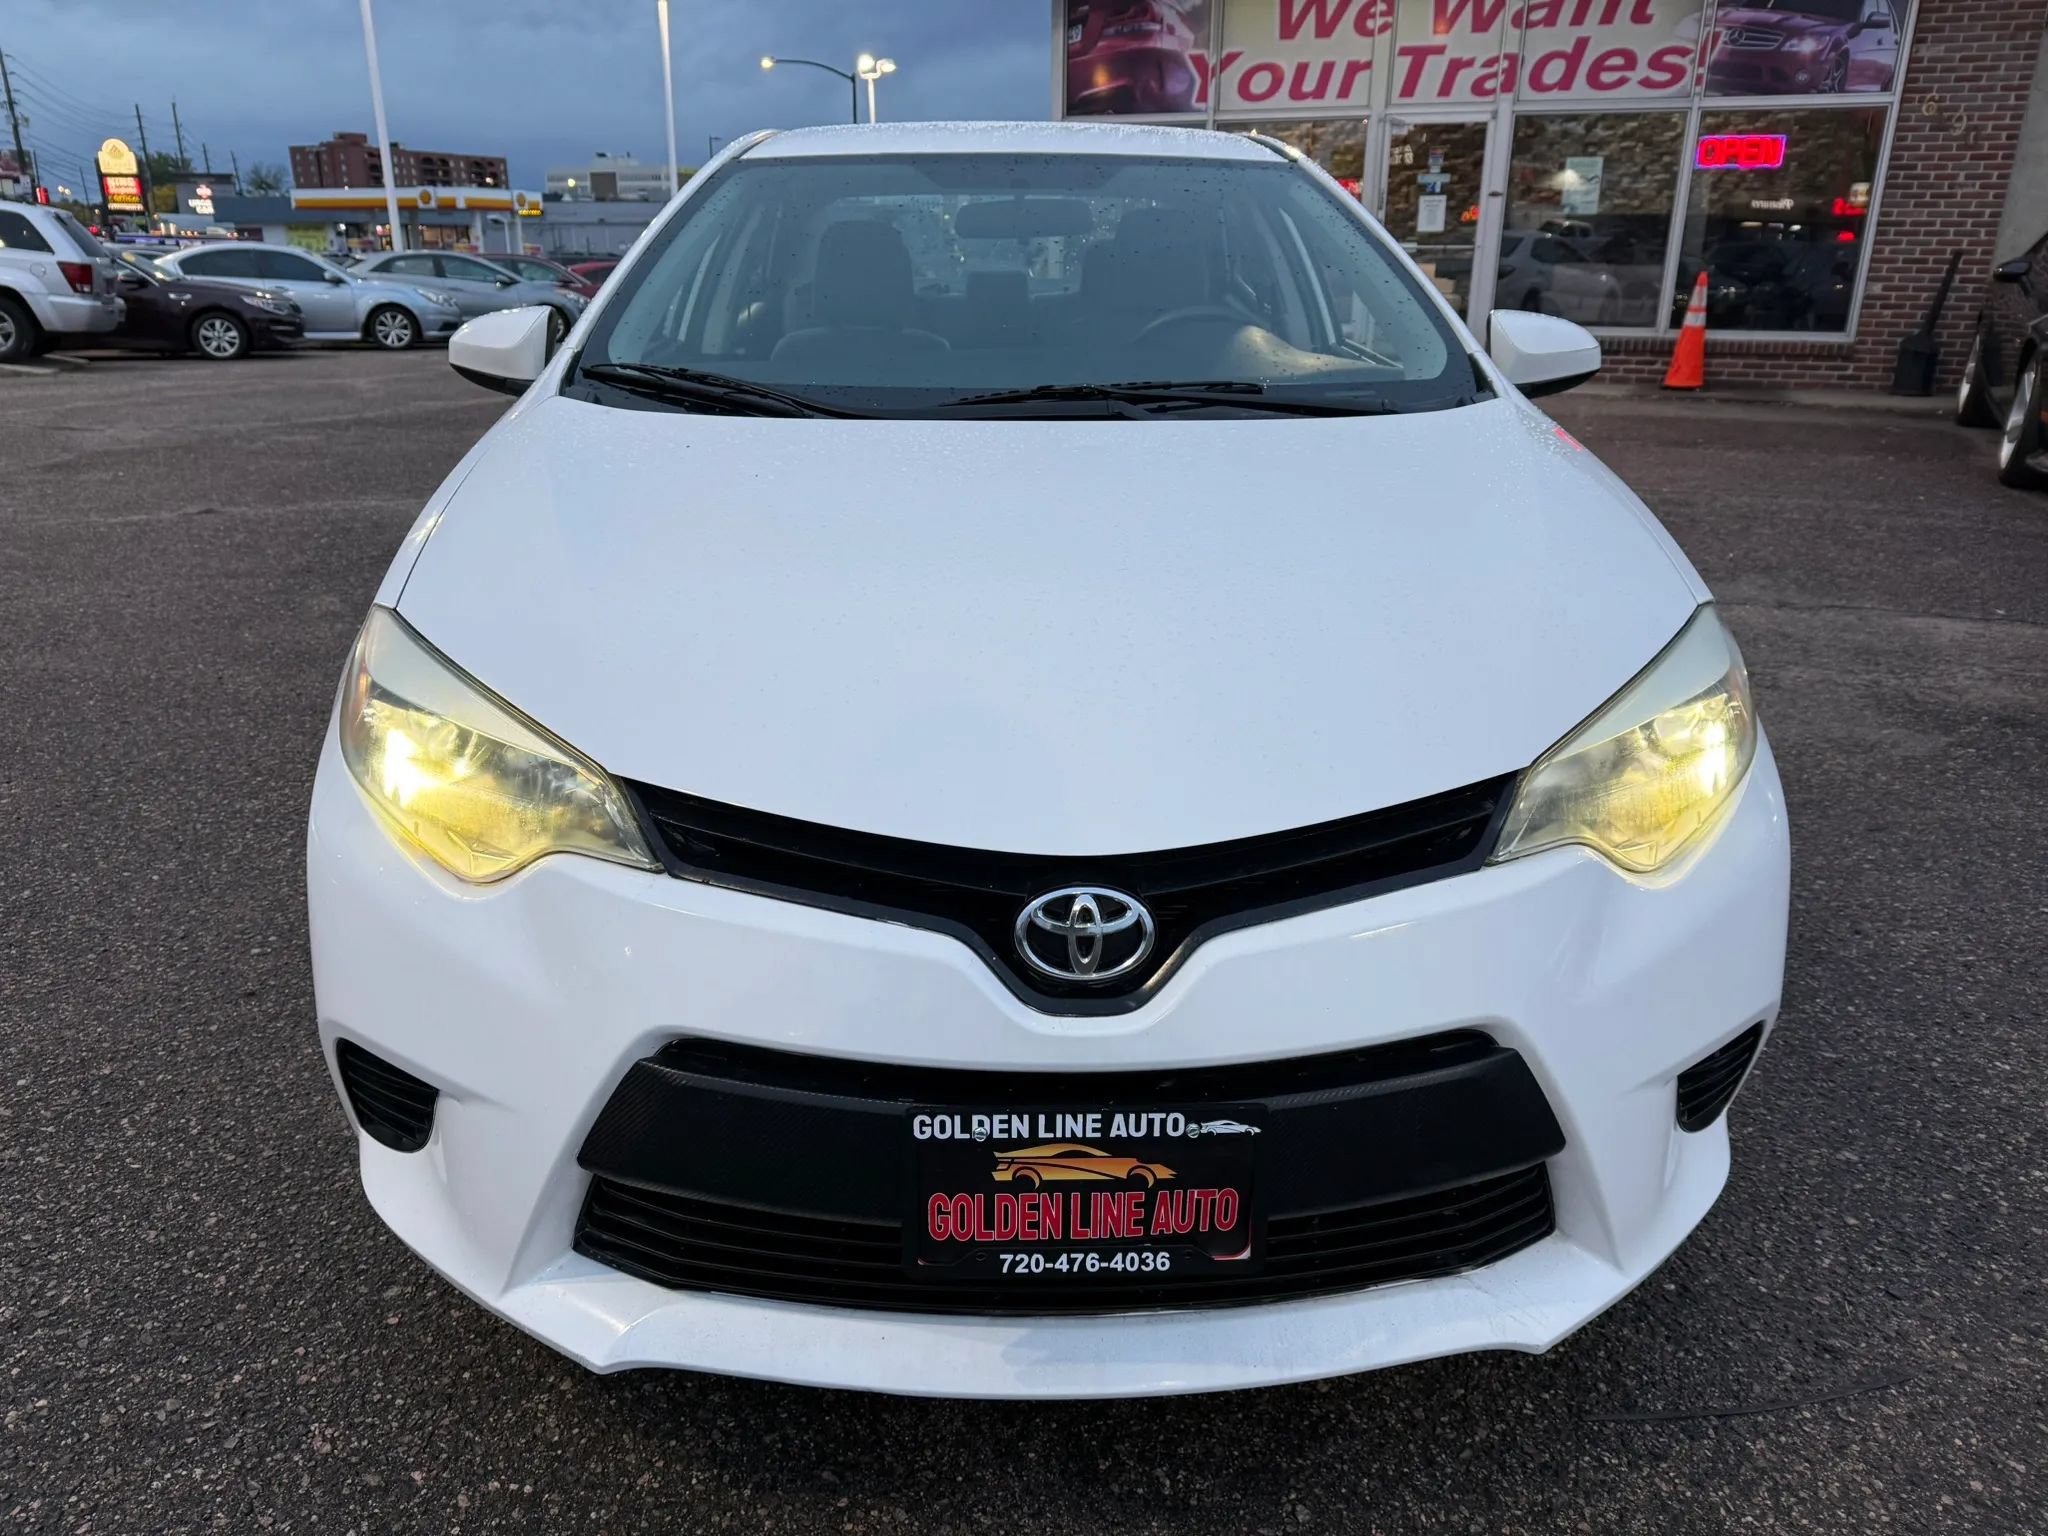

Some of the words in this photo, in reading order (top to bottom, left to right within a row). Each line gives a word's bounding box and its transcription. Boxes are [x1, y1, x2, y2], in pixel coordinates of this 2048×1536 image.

[1278, 0, 1395, 40] We
[1431, 0, 1655, 36] Want
[1189, 50, 1373, 103] Your
[1397, 31, 1722, 98] Trades!
[1700, 137, 1782, 166] OPEN
[913, 1113, 1030, 1140] GOLDEN
[1039, 1113, 1102, 1139] LINE
[1109, 1112, 1186, 1138] AUTO
[928, 1192, 1063, 1242] GOLDEN
[1070, 1191, 1145, 1240] LINE
[1151, 1187, 1239, 1235] AUTO
[999, 1251, 1171, 1274] 720-476-4036
